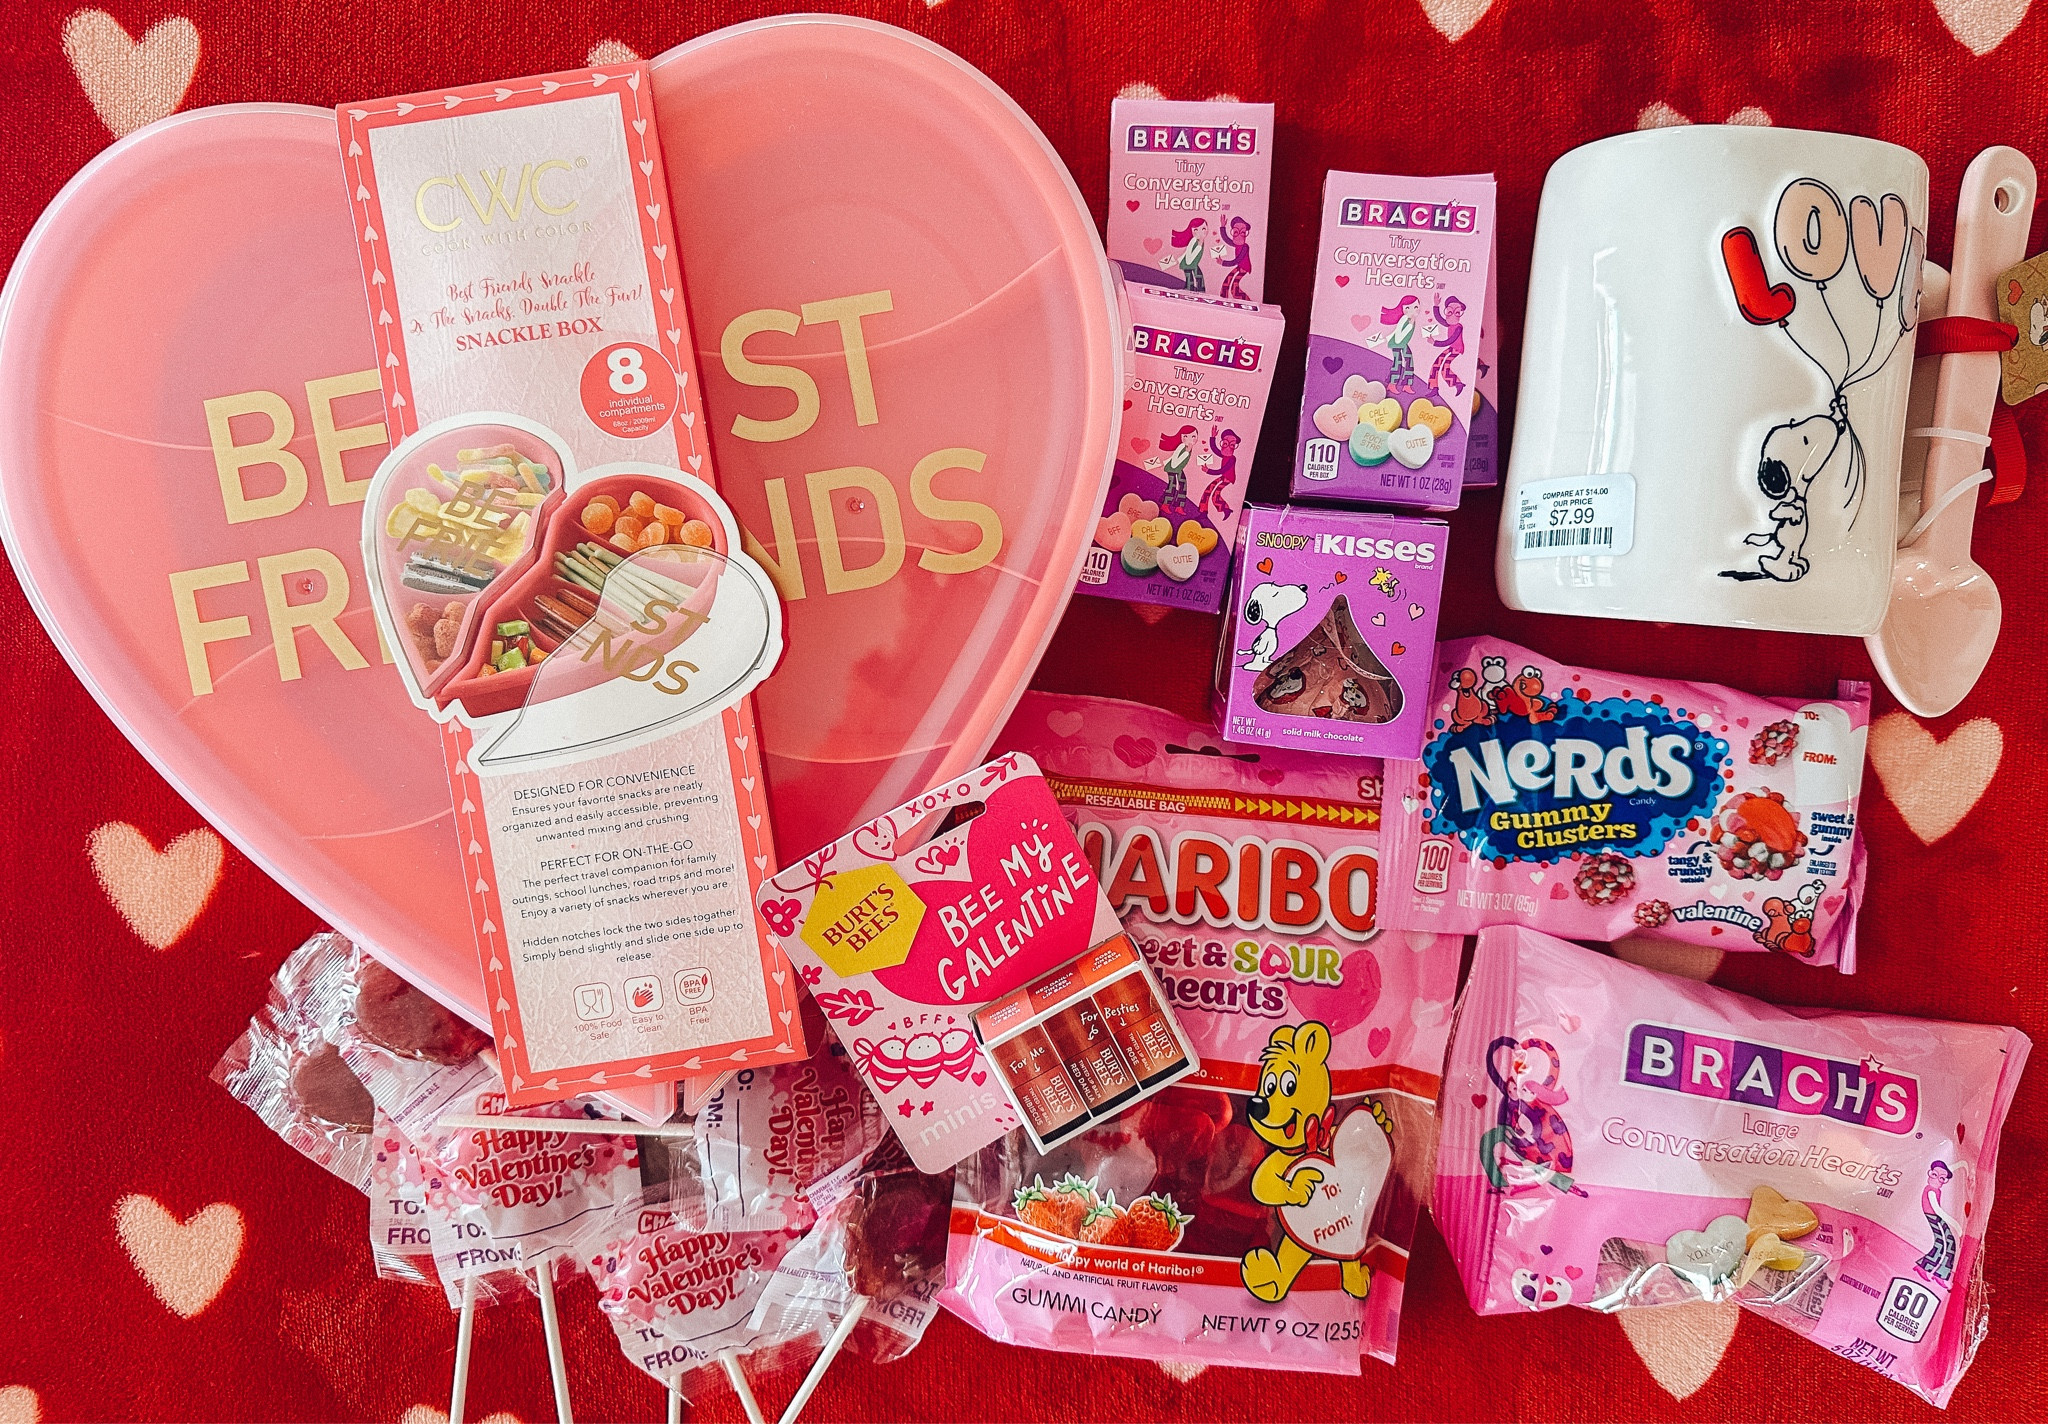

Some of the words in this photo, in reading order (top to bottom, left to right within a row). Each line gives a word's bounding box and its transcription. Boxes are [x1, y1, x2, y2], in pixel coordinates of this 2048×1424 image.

[1175, 159, 1205, 176] Tiny
[415, 159, 579, 233] CWC
[1123, 173, 1254, 194] Conversation
[1155, 193, 1221, 211] Hearts
[1389, 234, 1421, 253] Tiny
[1333, 247, 1471, 273] Conversation
[447, 281, 473, 303] Best
[479, 271, 533, 299] Friends
[538, 261, 595, 287] Snackle
[1365, 269, 1435, 290] Hearts
[430, 307, 455, 330] The
[520, 291, 568, 316] Double
[573, 286, 600, 309] The
[605, 284, 643, 307] Fun!
[456, 323, 553, 352] SNACKLE
[557, 316, 604, 337] BOX
[607, 348, 648, 395] 8
[1174, 366, 1204, 385] Tiny
[609, 395, 653, 408] individual
[1131, 378, 1251, 410] onversation
[600, 402, 666, 418] compartments
[1147, 395, 1214, 421] Hearts
[1368, 408, 1389, 419] CALL
[1374, 416, 1385, 426] ME
[1309, 444, 1336, 463] 110
[1405, 438, 1428, 449] CUTIE
[1307, 463, 1334, 472] CALORIES
[1380, 474, 1398, 488] NET
[1398, 475, 1411, 488] WT
[1419, 477, 1431, 490] OZ
[1431, 477, 1452, 495] (28g)
[1543, 490, 1574, 500] COMPARE
[1585, 488, 1609, 496] $14.00
[1553, 500, 1568, 508] OUR
[1570, 498, 1593, 506] PRICE
[1549, 507, 1594, 527] $7.99
[1256, 533, 1310, 551] SNOOPY
[1803, 711, 1819, 720] TO:
[1283, 727, 1302, 737] solid
[1304, 729, 1321, 738] milk
[1323, 731, 1364, 742] chocolate
[1803, 752, 1837, 764] FROM:
[513, 783, 576, 801] DESIGNED
[578, 778, 604, 792] FOR
[606, 764, 697, 787] CONVENIENCE
[511, 803, 551, 816] Ensures
[553, 800, 576, 813] your
[578, 793, 616, 807] favorite
[618, 789, 652, 801] snacks
[655, 786, 671, 795] are
[673, 779, 703, 792] neatly
[1085, 794, 1156, 812] RESEALABLE
[1159, 798, 1186, 813] BAG
[1629, 797, 1656, 806] Candy
[502, 818, 552, 833] organized
[554, 814, 574, 825] and
[576, 808, 605, 821] easily
[606, 802, 661, 818] accessible,
[664, 793, 719, 810] preventing
[1489, 803, 1612, 832] Gummy
[1811, 812, 1845, 824] sweet
[535, 827, 585, 843] unwanted
[587, 822, 622, 835] mixing
[624, 818, 644, 830] and
[646, 812, 690, 827] crushing
[1810, 824, 1852, 840] gummy
[540, 854, 592, 872] PERFECT
[595, 850, 619, 863] FOR
[622, 839, 694, 860] ON-THE-GO
[1422, 845, 1449, 871] 100
[1668, 856, 1699, 868] tangy
[522, 878, 542, 889] The
[544, 873, 579, 887] perfect
[581, 868, 609, 881] travel
[611, 860, 669, 877] companion
[670, 857, 686, 867] for
[687, 852, 717, 864] family
[1668, 865, 1712, 877] crunchy
[822, 883, 895, 947] BURT'S
[937, 884, 1003, 949] BEE
[1675, 901, 1762, 930] valentine
[846, 904, 899, 953] BEES
[1203, 942, 1226, 967] &
[1081, 1011, 1098, 1028] For
[1104, 1002, 1140, 1018] Besties
[1142, 1032, 1165, 1060] BEES
[1150, 1021, 1177, 1059] BURT'S
[1010, 1058, 1027, 1074] For
[1029, 1047, 1045, 1061] Me
[1125, 1047, 1139, 1066] ROSE
[1050, 1075, 1077, 1113] BURT'S
[1070, 1063, 1083, 1078] RED
[1078, 1077, 1094, 1102] DAHLIA
[1022, 1096, 1044, 1126] HIBISCUS
[1042, 1087, 1065, 1114] BEES
[920, 1090, 997, 1146] minis
[1742, 1112, 1800, 1142] Large
[472, 1128, 567, 1163] Happy
[764, 1106, 794, 1177] Day!
[1602, 1116, 1797, 1167] Conversation
[1801, 1146, 1901, 1186] Hearts
[455, 1144, 595, 1189] Valentine's
[491, 1177, 564, 1209] Day!
[1323, 1183, 1341, 1200] To:
[453, 1224, 486, 1238] TO:
[1314, 1215, 1353, 1243] From:
[456, 1248, 521, 1268] FROM:
[639, 1232, 731, 1276] Happy
[1094, 1256, 1129, 1271] world
[1132, 1260, 1146, 1272] of
[628, 1244, 763, 1302] Valentine's
[1052, 1270, 1071, 1281] AND
[1072, 1273, 1115, 1287] ARTIFICIAL
[1117, 1278, 1140, 1289] FRUIT
[1141, 1281, 1178, 1293] FLAVORS
[667, 1282, 737, 1315] Day!
[1013, 1287, 1085, 1313] GUMMI
[1091, 1301, 1162, 1324] CANDY
[1892, 1284, 1929, 1319] 60
[1202, 1314, 1238, 1332] NET
[1238, 1317, 1270, 1334] WT
[1275, 1319, 1285, 1335] 9
[1292, 1321, 1319, 1340] OZ
[1887, 1308, 1920, 1329] CALORIES
[643, 1346, 708, 1371] FROM:
